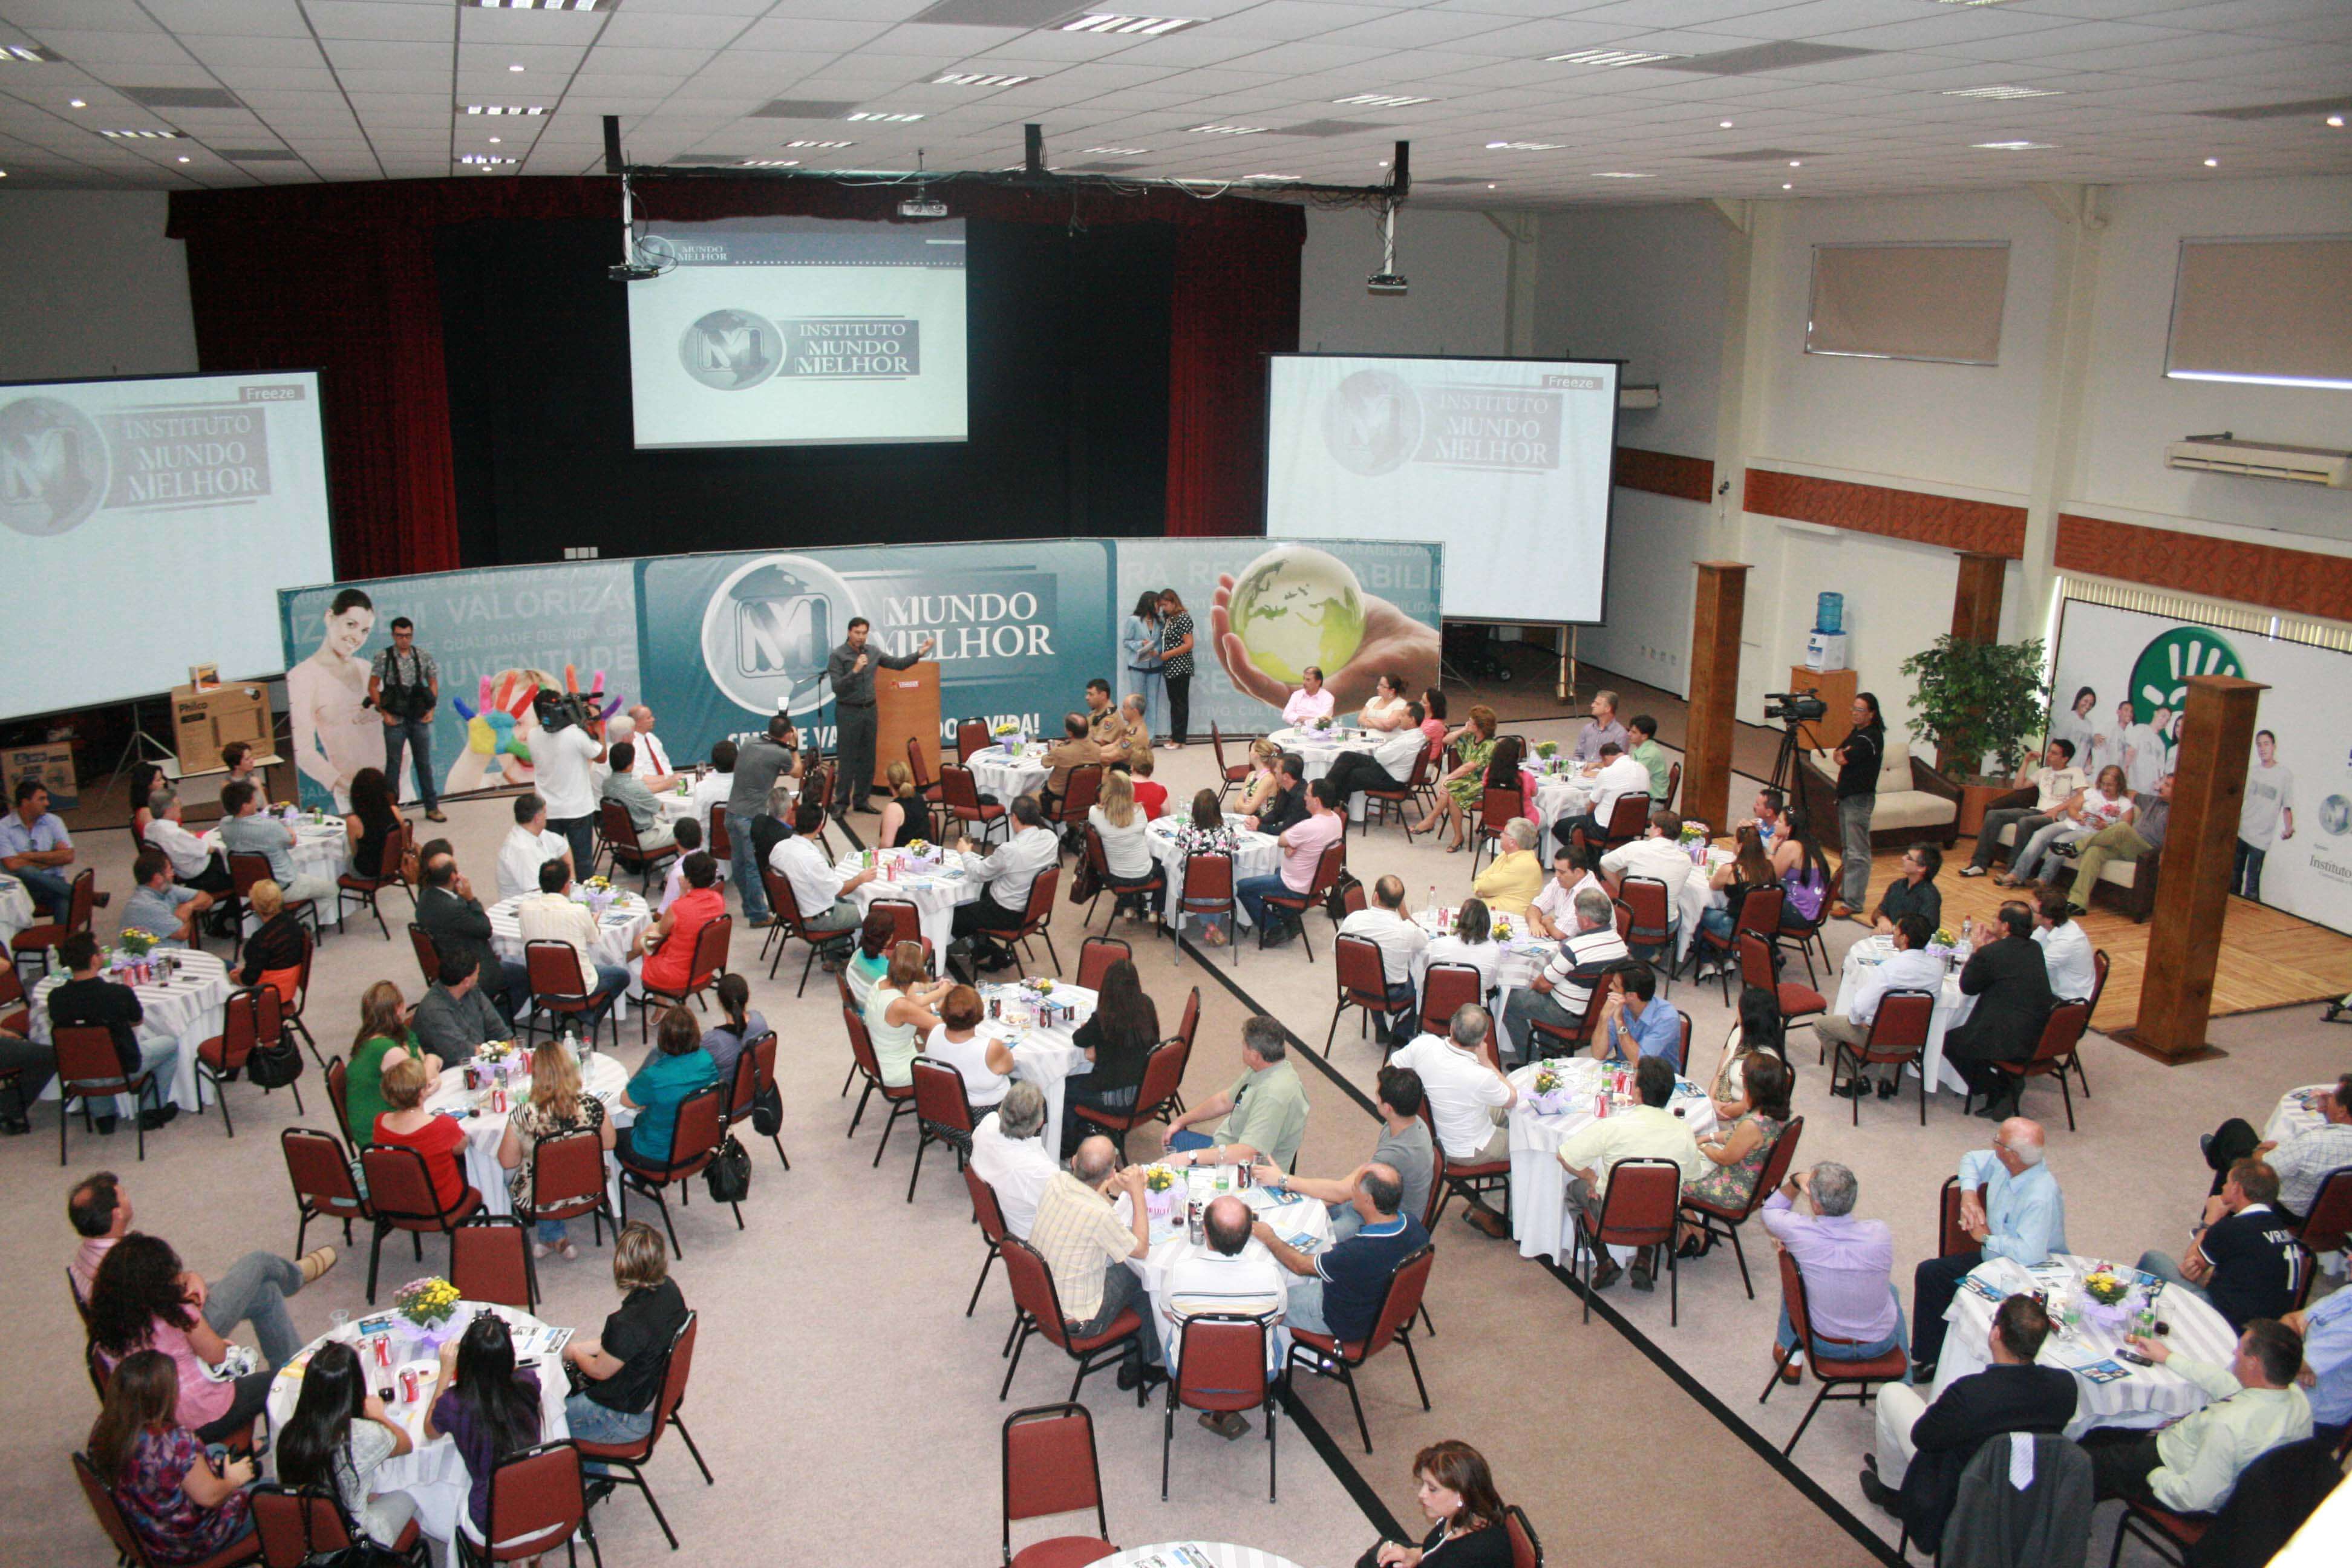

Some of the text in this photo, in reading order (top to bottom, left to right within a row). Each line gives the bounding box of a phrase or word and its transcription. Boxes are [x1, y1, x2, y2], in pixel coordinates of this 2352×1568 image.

[678, 253, 728, 261] MELHOR
[682, 245, 724, 253] MUNDO
[799, 323, 906, 338] INSTITUTO
[805, 340, 900, 356] MUNDO
[795, 356, 911, 374] MELHOR
[246, 386, 295, 400] Freeze
[1548, 375, 1595, 390] Freeze
[1439, 393, 1550, 415] INSTITUTO
[125, 414, 252, 440] INSTITUTO
[1446, 416, 1541, 440] MUNDO
[136, 441, 246, 472] MUNDO
[1434, 437, 1549, 465] MELHOR
[128, 466, 260, 501] MELHOR
[883, 592, 1037, 627] MUNDO
[443, 630, 532, 652] QUALIDADE
[535, 629, 560, 642] DE
[869, 624, 1056, 661] MELHOR
[178, 700, 209, 713] Philco
[2309, 854, 2352, 878] Instituto
